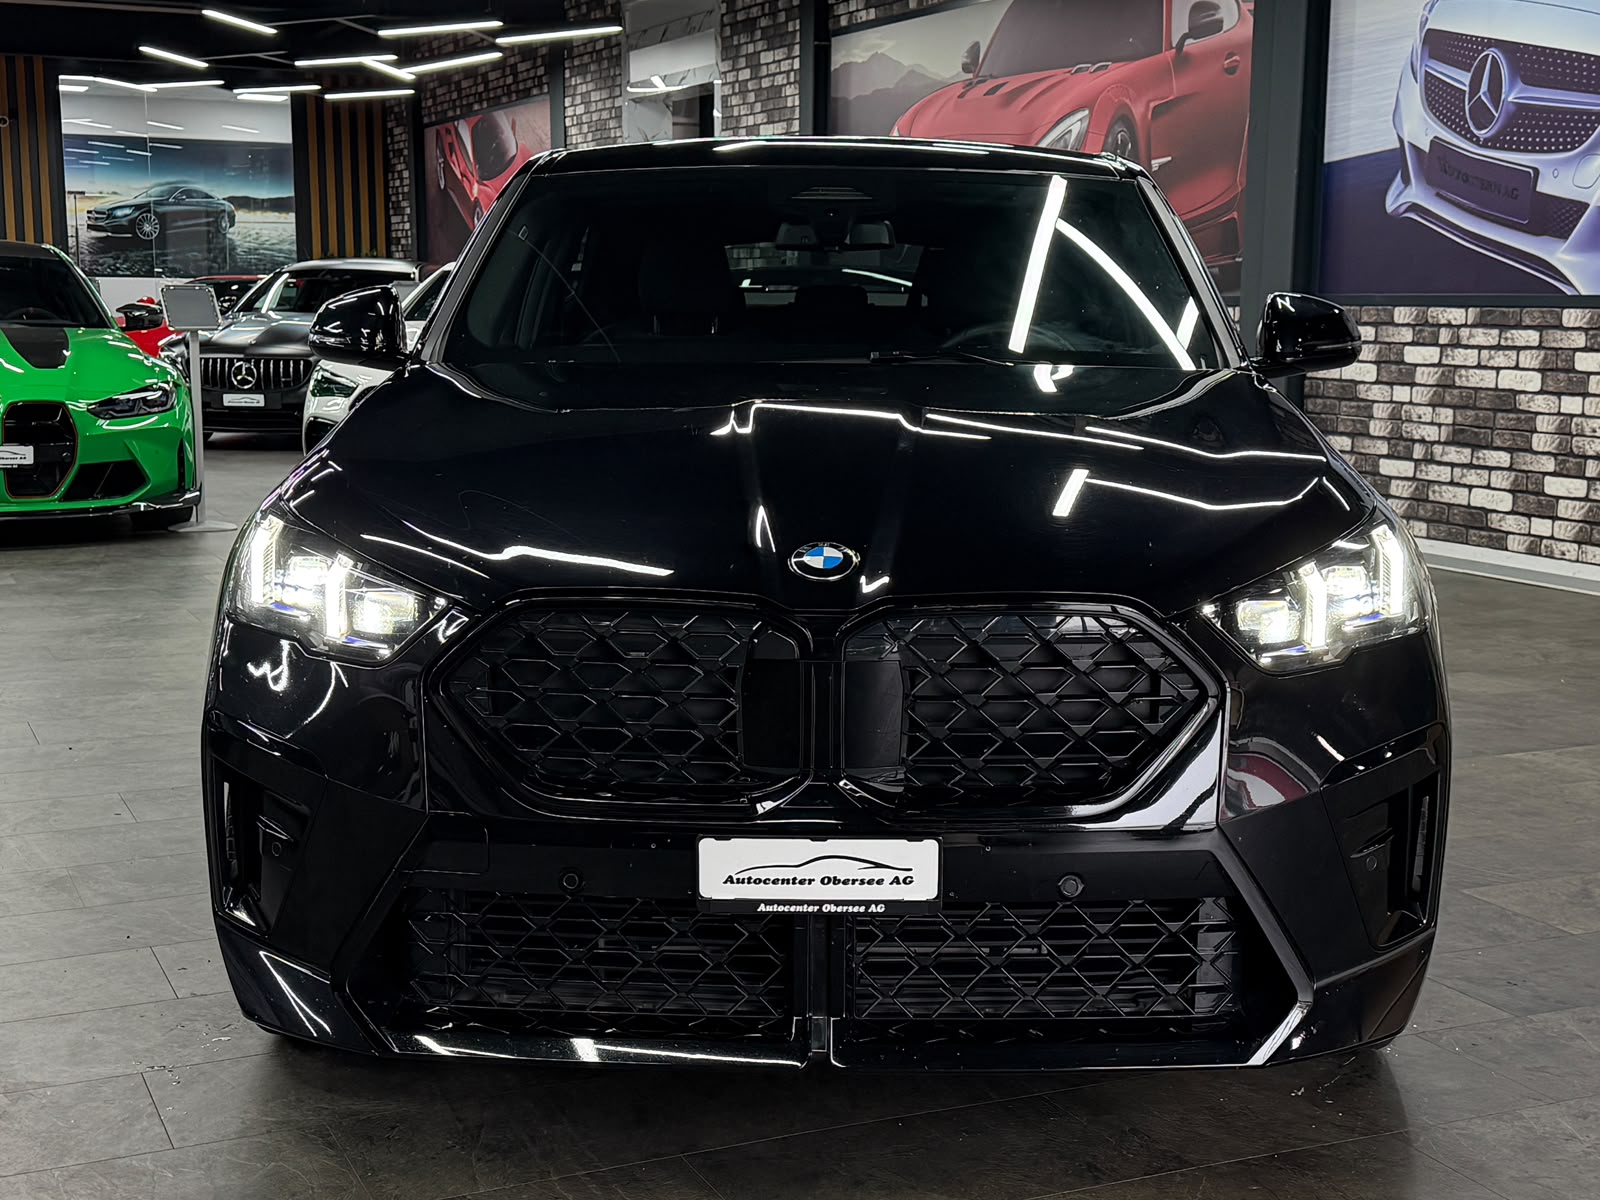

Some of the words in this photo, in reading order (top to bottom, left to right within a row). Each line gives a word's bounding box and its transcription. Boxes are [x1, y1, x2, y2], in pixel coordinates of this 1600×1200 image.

[722, 874, 816, 886] Autocenter
[819, 875, 885, 886] Obersee
[888, 875, 915, 886] AG
[756, 902, 820, 913] Autocenter
[821, 903, 866, 913] Obersee
[867, 903, 886, 913] AG
